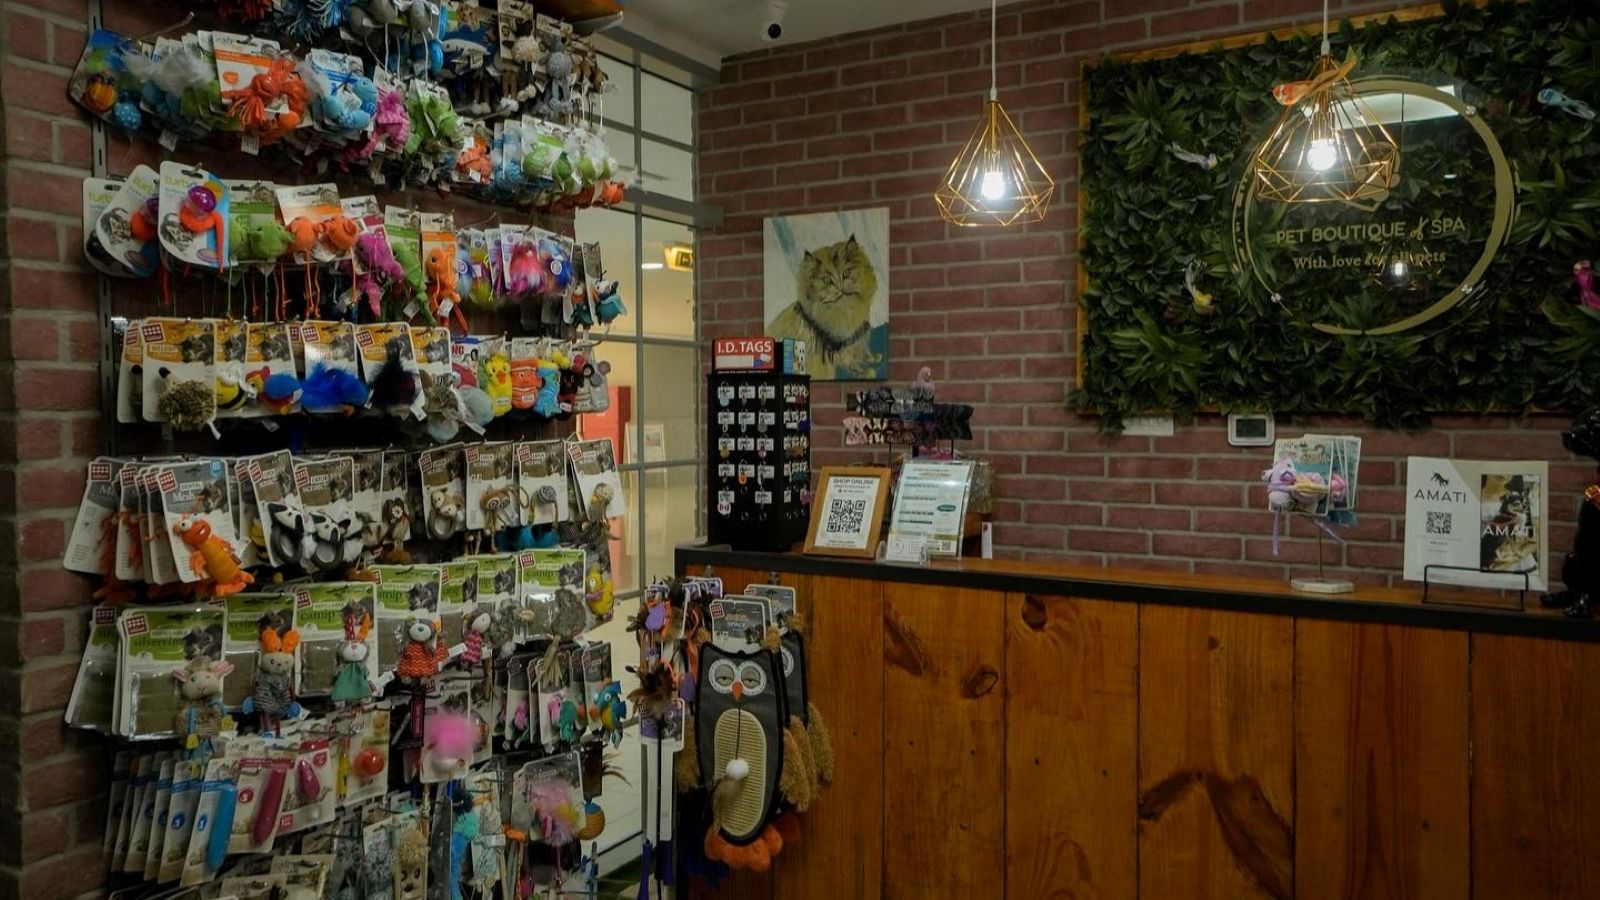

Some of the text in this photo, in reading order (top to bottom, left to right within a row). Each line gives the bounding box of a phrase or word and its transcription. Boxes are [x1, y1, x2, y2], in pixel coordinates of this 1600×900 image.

[1276, 216, 1466, 244] PET BOUTIQUE SPA
[1292, 256, 1327, 270] With
[1332, 256, 1361, 268] love
[717, 341, 772, 353] I.D. TAGS
[1414, 488, 1466, 504] AMATI
[1482, 525, 1537, 538] AMATI
[300, 611, 335, 622] catnip
